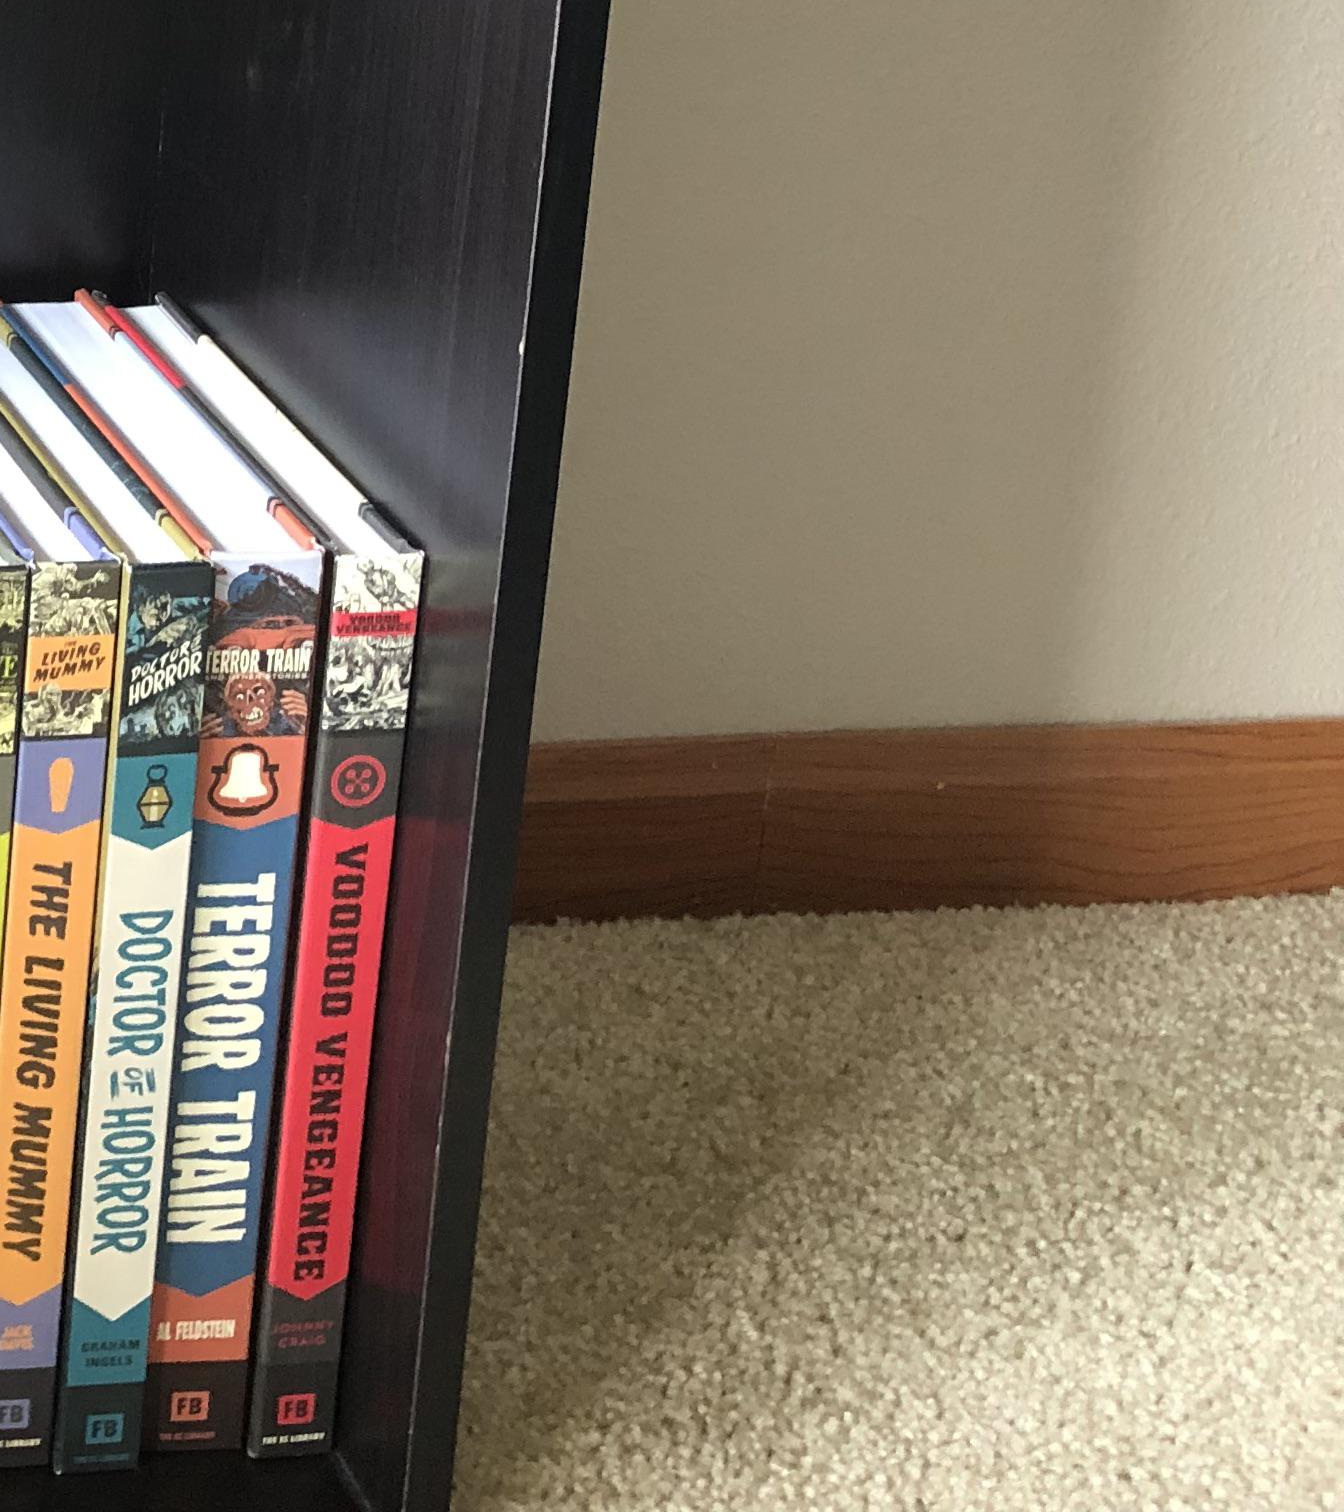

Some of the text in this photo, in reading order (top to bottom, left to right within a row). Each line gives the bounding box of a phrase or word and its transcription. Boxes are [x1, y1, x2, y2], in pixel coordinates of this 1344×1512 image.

[33, 656, 106, 682] MUMMY
[41, 642, 101, 667] LIVING
[128, 652, 203, 707] HORROR
[108, 909, 175, 1058] DOCTOR
[2, 860, 73, 1262] THE LIVING MUMMY
[166, 872, 277, 1246] TERROR TRAIN
[292, 843, 370, 1283] VOODOO VENGEANCE
[89, 1104, 161, 1256] HORROR
[80, 1339, 140, 1354] GRAHAM
